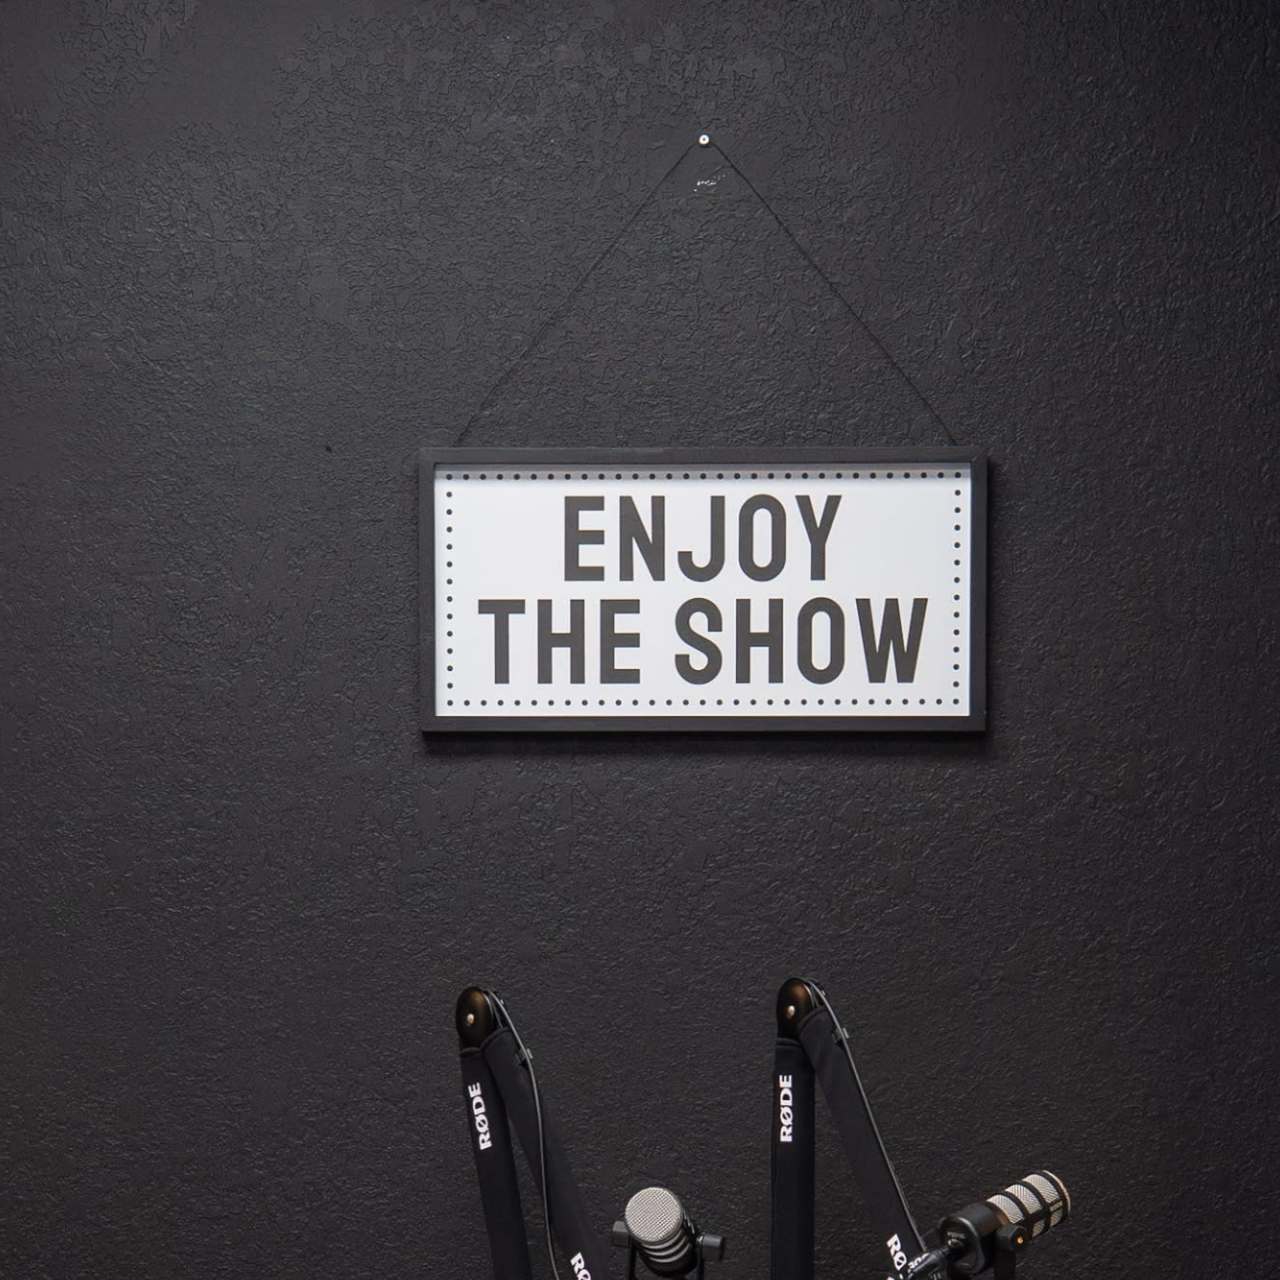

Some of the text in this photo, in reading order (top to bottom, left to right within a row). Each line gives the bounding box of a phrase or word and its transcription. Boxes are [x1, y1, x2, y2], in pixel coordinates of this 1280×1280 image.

[564, 494, 842, 582] ENJOY
[478, 597, 929, 685] THE SHOW
[467, 1082, 492, 1150] RØDE
[779, 1074, 793, 1142] RØDE
